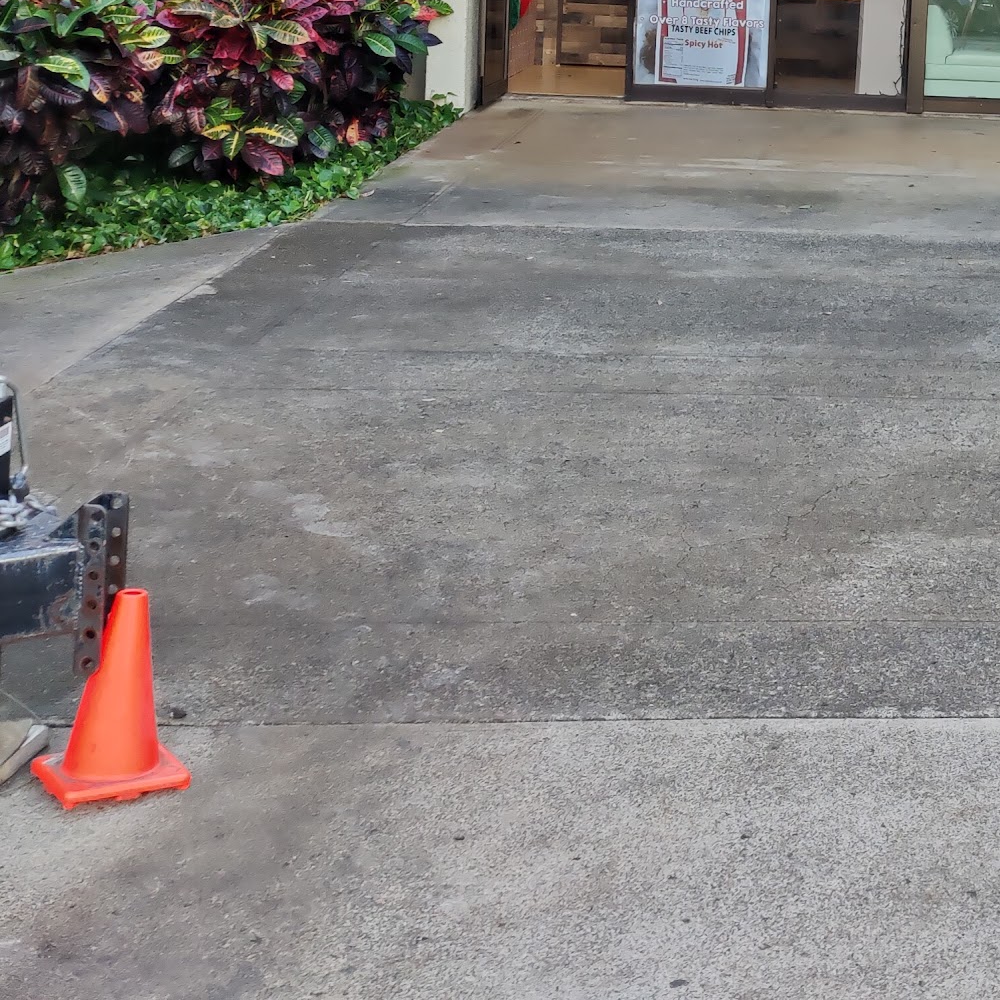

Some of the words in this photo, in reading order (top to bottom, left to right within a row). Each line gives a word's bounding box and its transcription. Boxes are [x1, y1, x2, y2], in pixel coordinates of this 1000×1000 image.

[650, 15, 678, 24] Over
[681, 16, 688, 24] 8
[690, 16, 720, 28] Tasty
[724, 18, 764, 28] Flavors
[672, 24, 694, 34] TASTY
[695, 26, 712, 34] BEEF
[714, 28, 736, 36] CHIPS
[684, 39, 706, 50] Spicy
[708, 40, 724, 49] Hot
